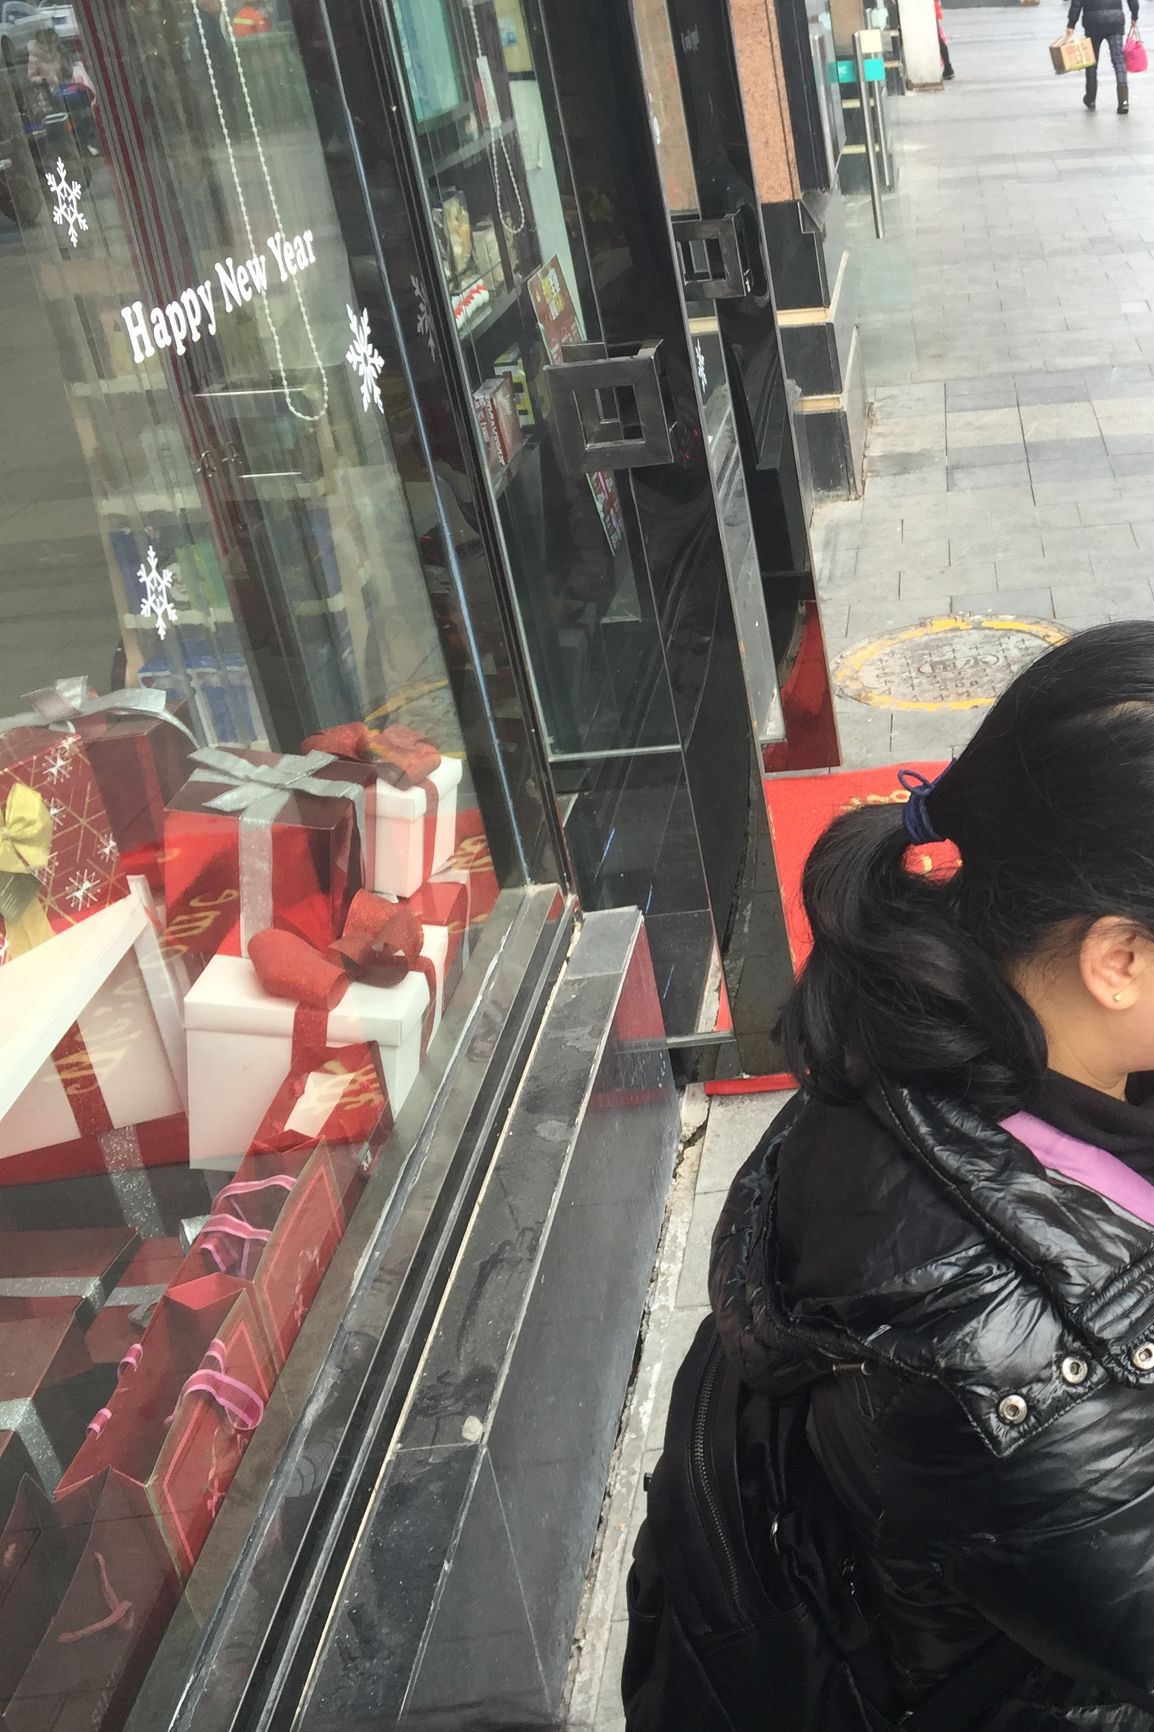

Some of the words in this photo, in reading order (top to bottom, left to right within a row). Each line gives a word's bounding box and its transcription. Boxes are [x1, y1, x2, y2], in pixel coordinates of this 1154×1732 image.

[121, 280, 216, 363] Happy
[215, 255, 268, 312] New
[267, 229, 316, 282] Year
